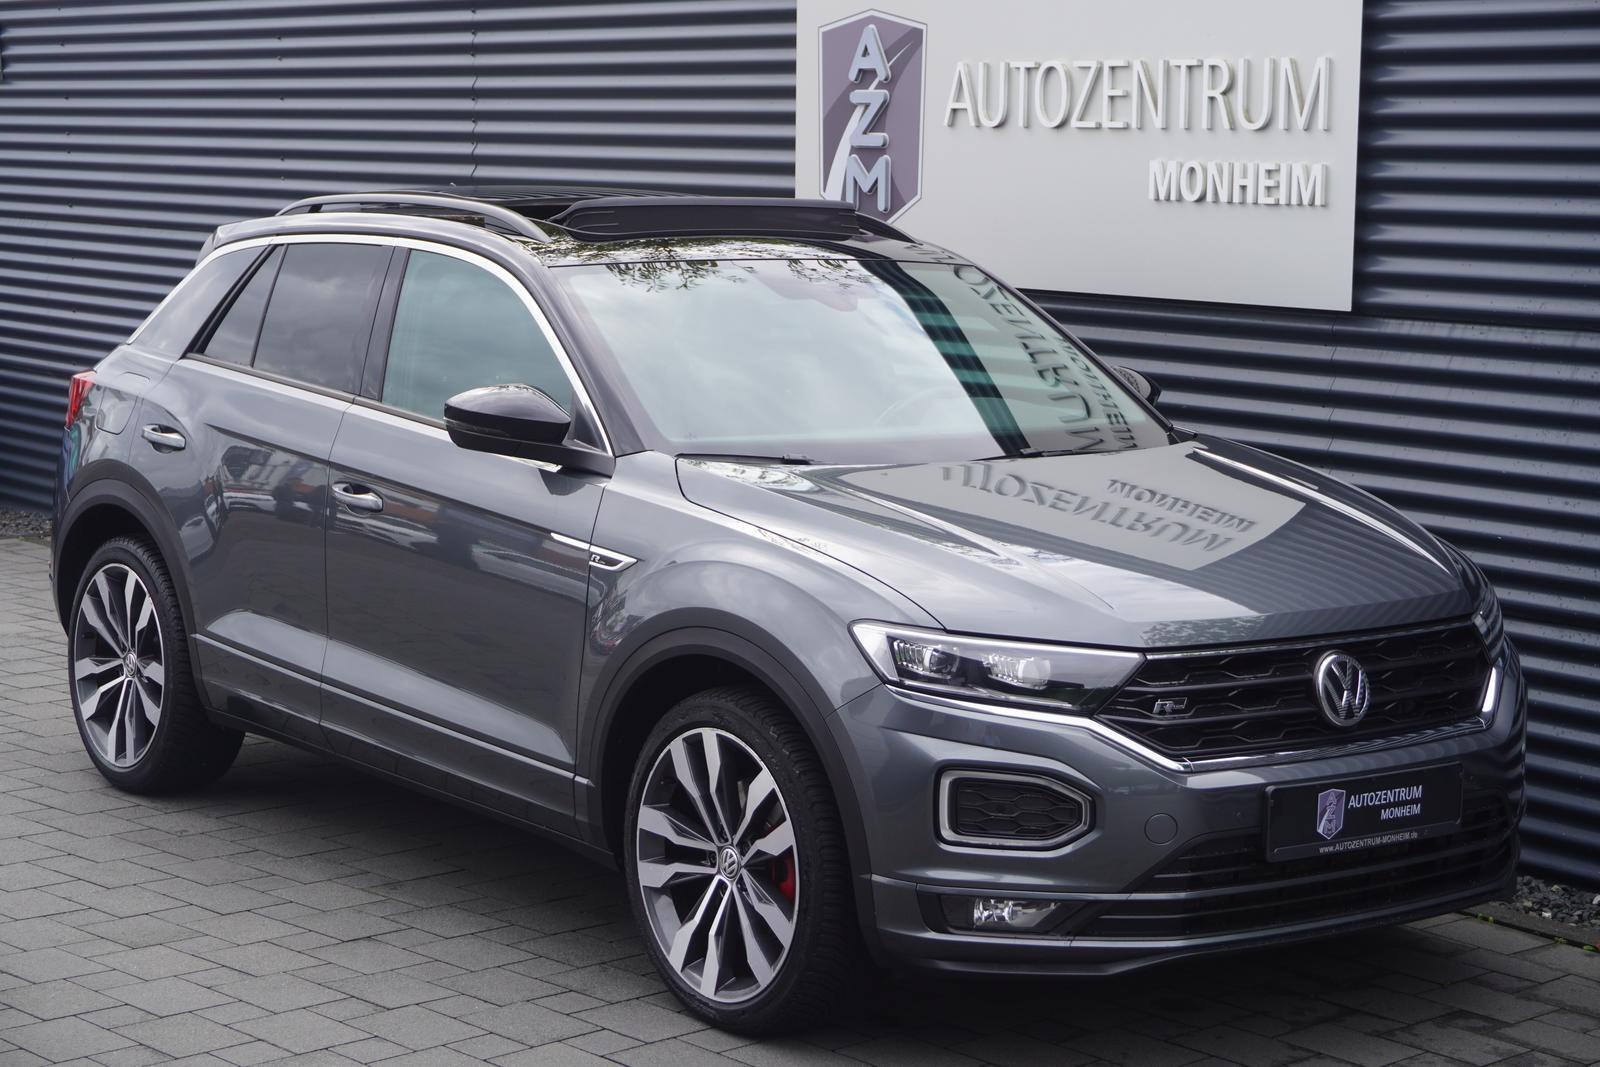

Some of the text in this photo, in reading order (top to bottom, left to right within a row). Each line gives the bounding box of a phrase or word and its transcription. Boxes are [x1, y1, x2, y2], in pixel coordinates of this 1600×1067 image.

[943, 56, 1331, 132] AUTOZENTRUM
[847, 23, 892, 213] AZM
[1148, 159, 1327, 206] MONHEIM
[1347, 785, 1423, 809] AUTOZENTRUM
[1380, 803, 1421, 820] MONHEIM
[1319, 832, 1418, 853] www.AUTOZENTRUM-MONHEIM.de
